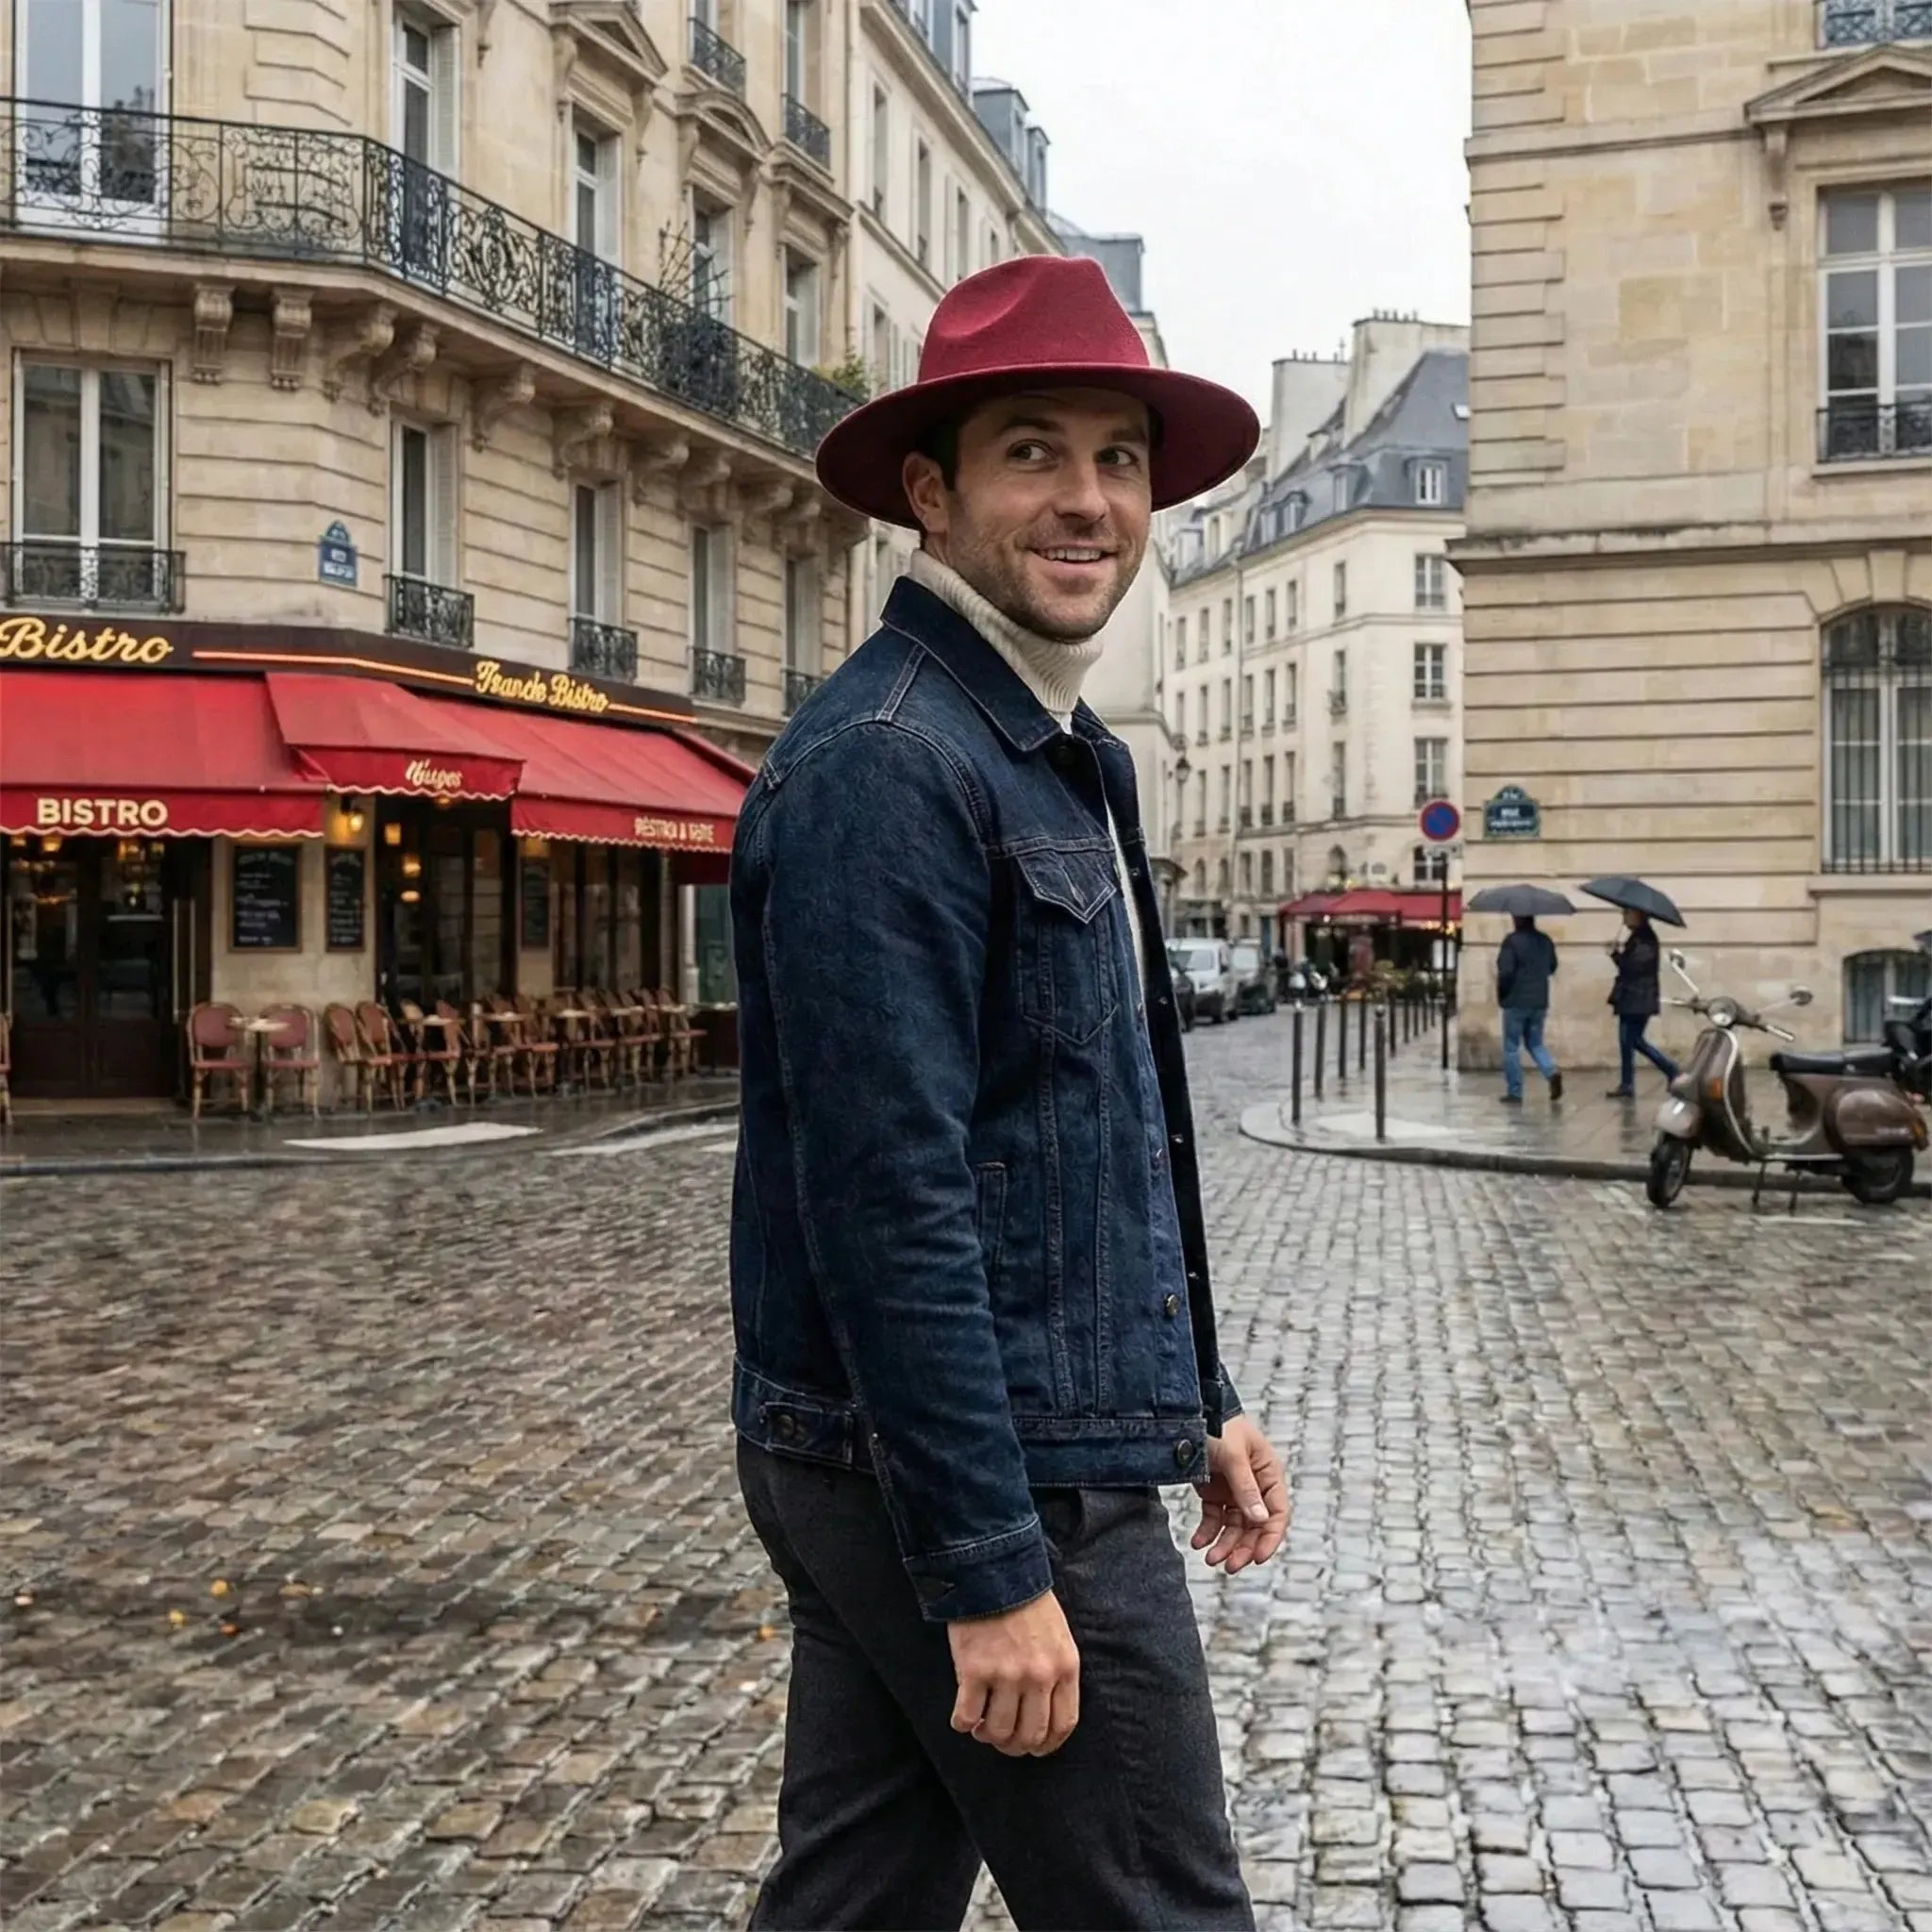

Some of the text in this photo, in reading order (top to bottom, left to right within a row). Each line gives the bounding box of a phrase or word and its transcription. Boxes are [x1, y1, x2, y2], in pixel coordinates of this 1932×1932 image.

[0, 616, 175, 664] Bistro
[548, 674, 608, 713] Bistro
[38, 797, 169, 826] BISTRO
